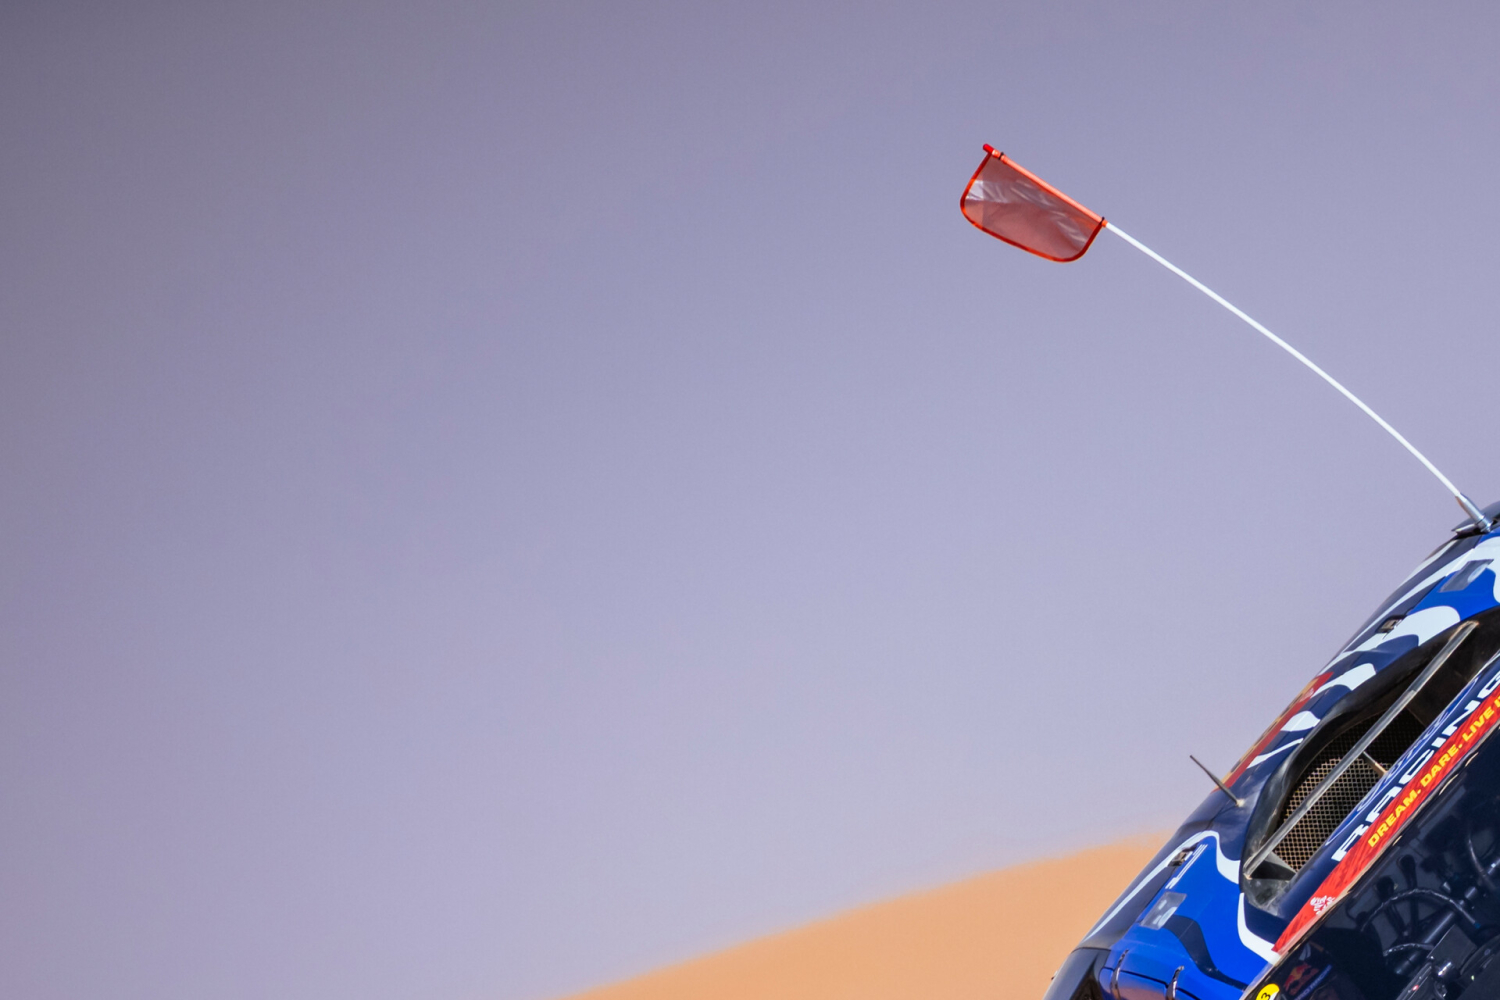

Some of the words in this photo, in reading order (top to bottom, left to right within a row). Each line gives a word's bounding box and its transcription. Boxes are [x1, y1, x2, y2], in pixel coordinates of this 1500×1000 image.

[1367, 788, 1422, 848] DREAM.
[1420, 743, 1463, 786] DARE.
[1462, 708, 1495, 741] LIVE
